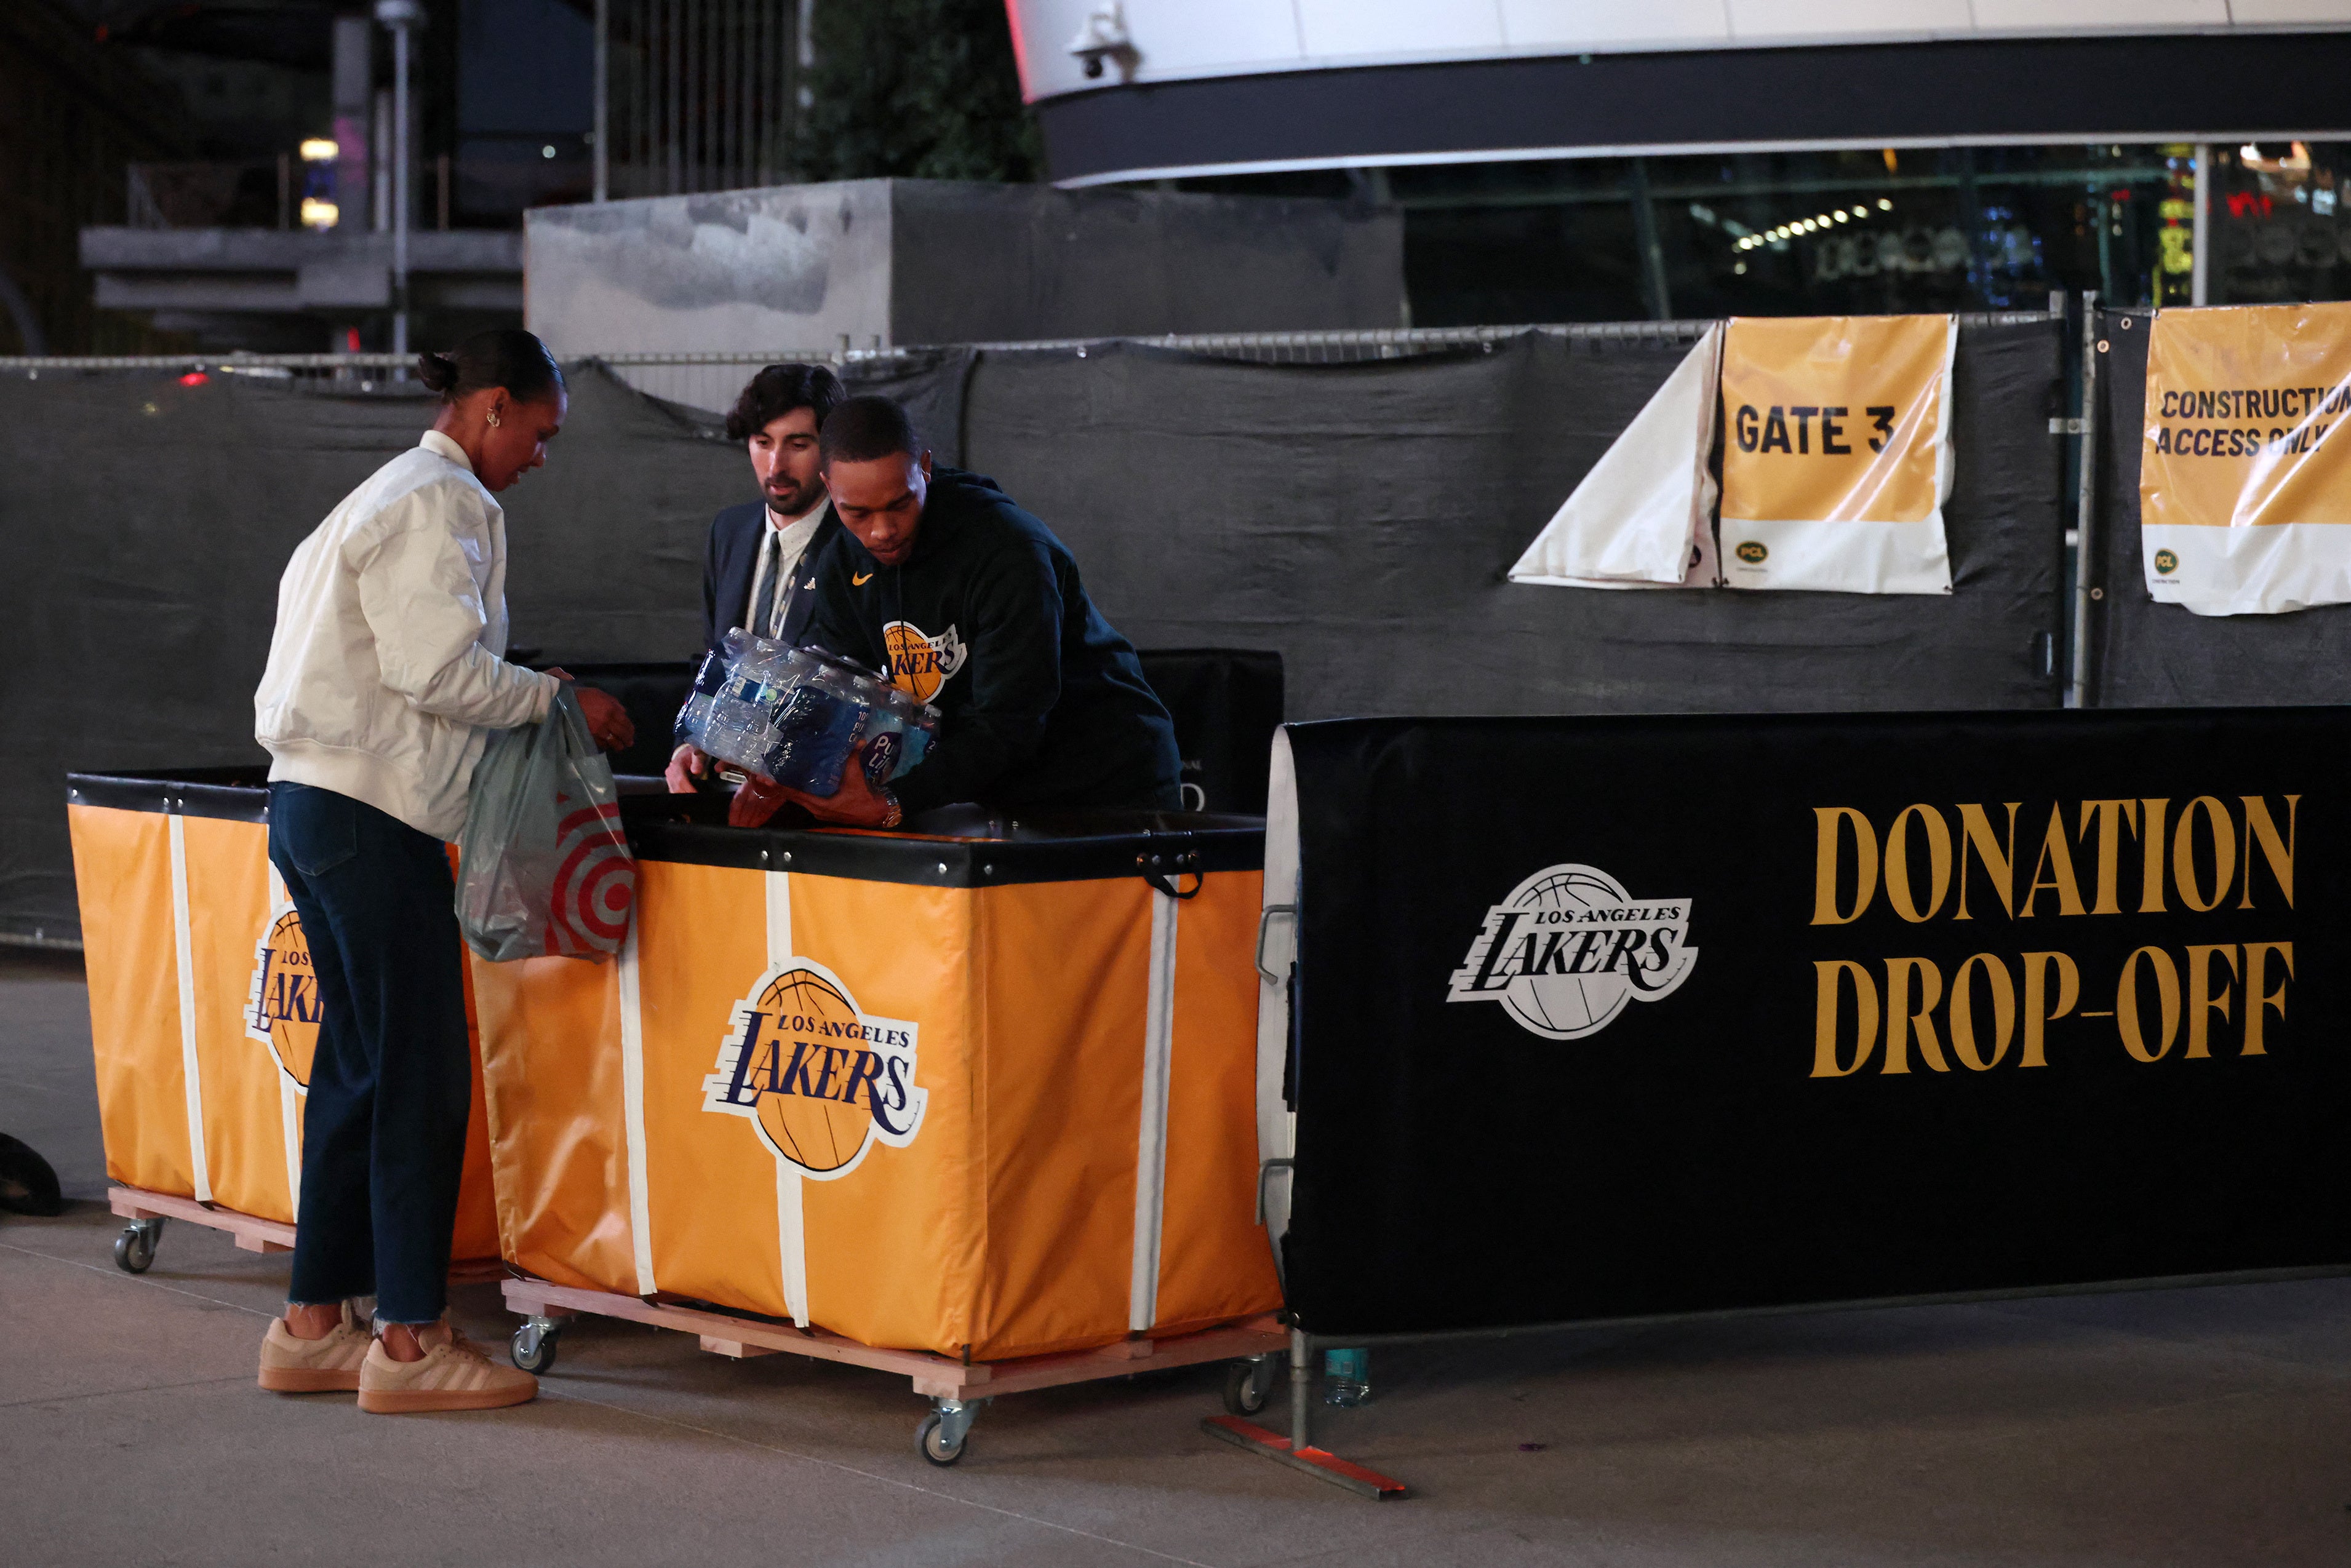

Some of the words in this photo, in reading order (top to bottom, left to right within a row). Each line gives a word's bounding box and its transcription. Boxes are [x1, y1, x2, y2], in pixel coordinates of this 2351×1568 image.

[1736, 405, 1851, 454] GATE
[1866, 406, 1895, 454] 3
[2155, 427, 2261, 456] ACCESS
[2269, 424, 2329, 455] ONLY
[1809, 794, 2302, 925] DONATION
[1535, 909, 1575, 924] LOS
[1579, 906, 1681, 923] ANGELES
[1459, 912, 1687, 992] LAKERS
[778, 1015, 815, 1032] LOS
[820, 1021, 910, 1048] ANGELES
[1809, 941, 2294, 1077] DROP-OFF
[712, 1010, 920, 1135] LAKERS
